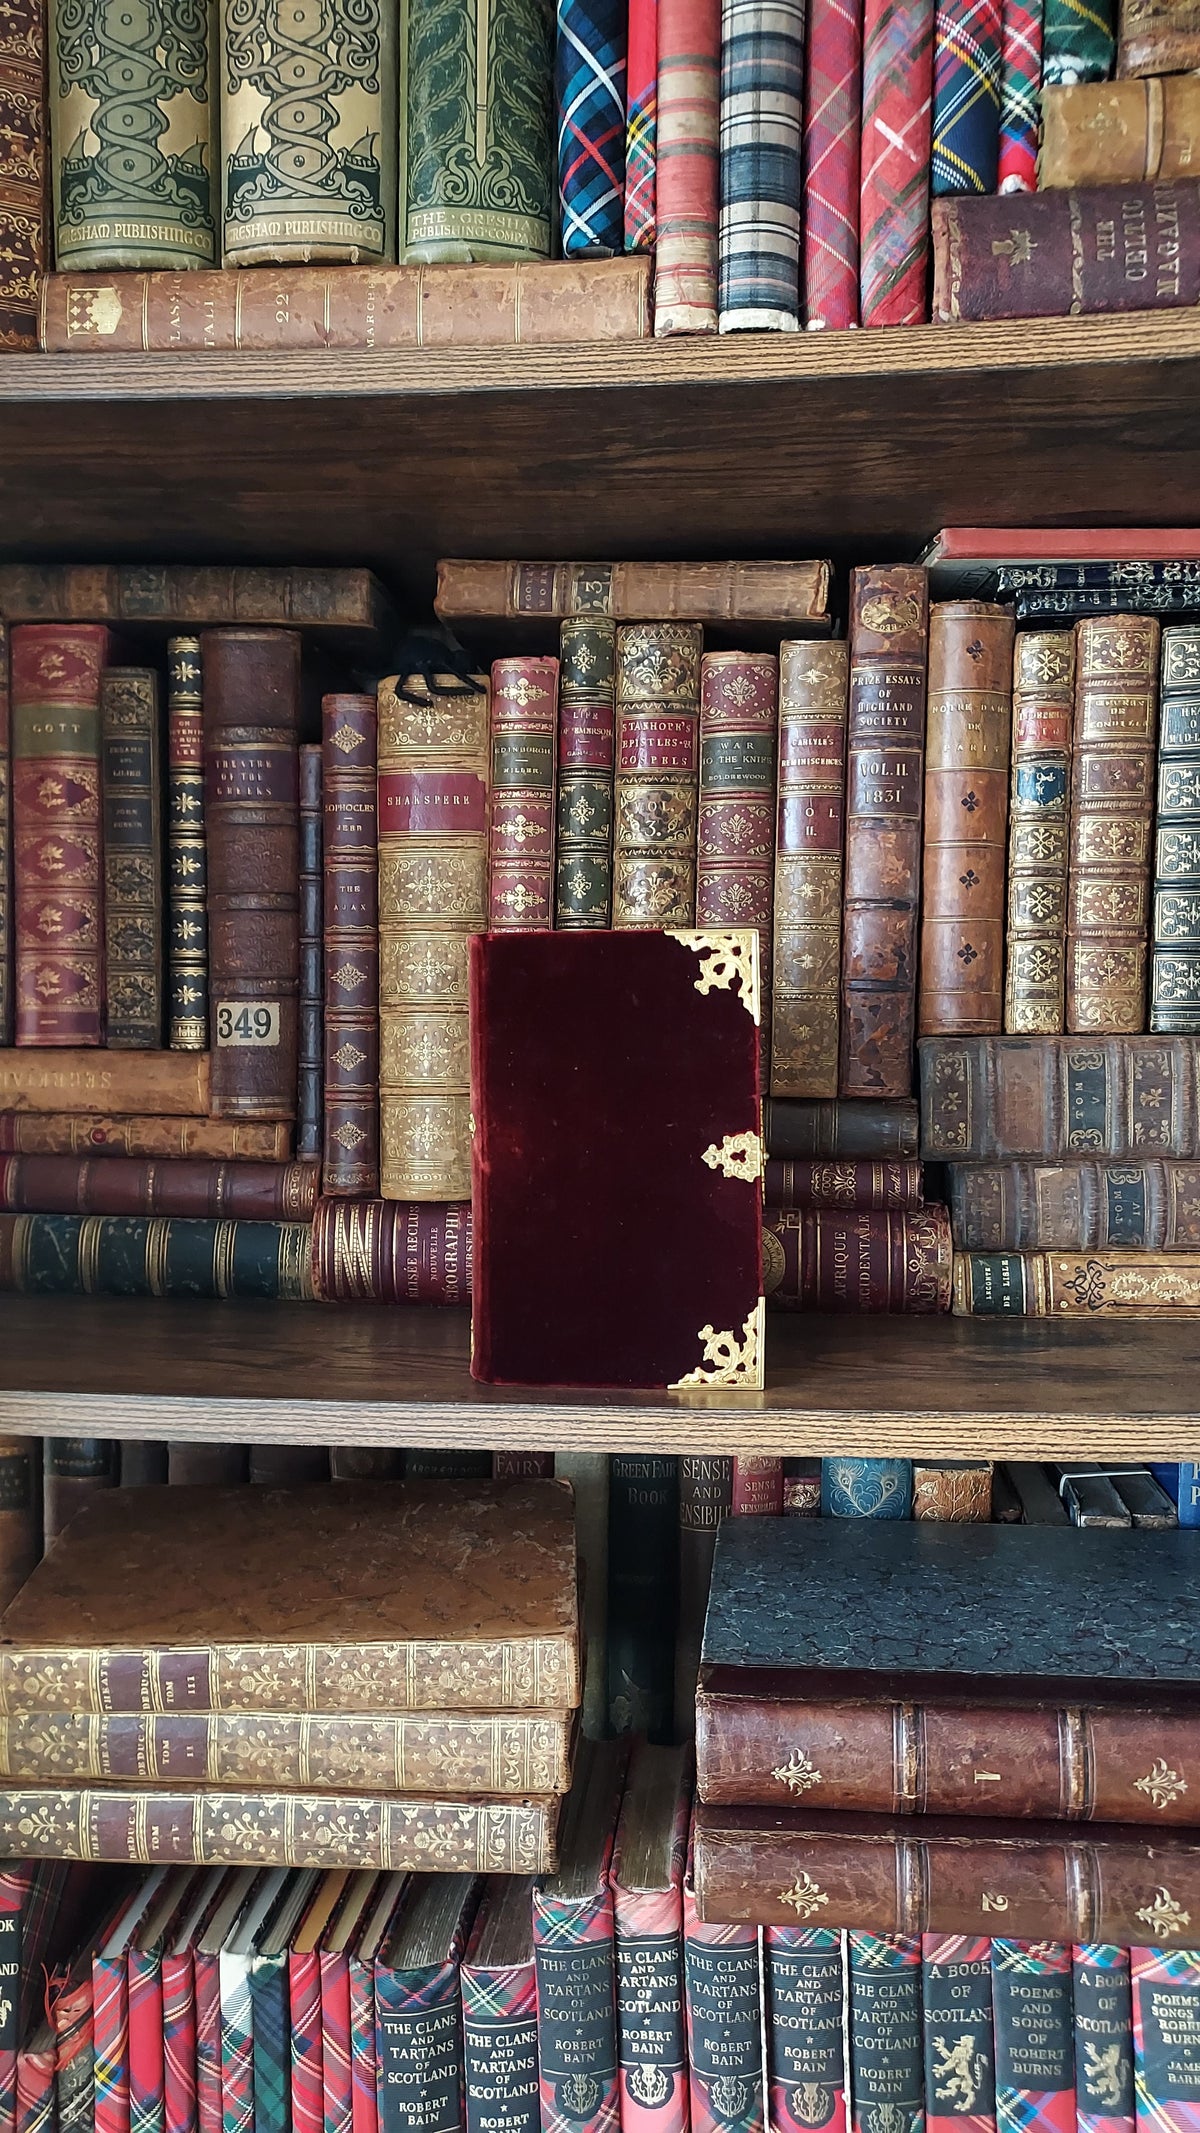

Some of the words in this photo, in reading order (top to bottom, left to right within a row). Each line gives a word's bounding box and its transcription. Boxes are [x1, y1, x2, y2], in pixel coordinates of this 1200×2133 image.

[412, 211, 447, 227] THE
[114, 223, 193, 245] PUBLISHING
[194, 233, 211, 250] CO
[285, 220, 362, 238] PUBLISHING
[364, 226, 381, 243] CO
[1096, 220, 1116, 262] THE
[1122, 199, 1148, 282] CELTIC
[275, 294, 290, 323] 22
[852, 675, 881, 686] PRIZE
[885, 674, 921, 685] ESSAYS
[878, 689, 892, 698] OF
[857, 703, 913, 713] HIGHLAND
[622, 721, 692, 733] STANHOPE'S
[860, 717, 908, 727] SOCIETY
[720, 741, 754, 751] WAR
[792, 735, 834, 747] CARLYLE'S
[215, 760, 272, 769] THEATRE
[622, 756, 688, 767] GOSPELS
[719, 755, 738, 763] THE
[708, 773, 766, 782] BOLDREWOOD
[387, 795, 470, 806] SHAKSPERE
[864, 789, 901, 804] 1831
[333, 903, 367, 911] AJAX
[218, 1007, 272, 1039] 349
[1075, 1082, 1084, 1119] TOM
[407, 1205, 420, 1252] RECLUS
[430, 1227, 438, 1281] NOUVELLE
[834, 1231, 849, 1298] AFRIQUE
[1002, 1259, 1011, 1288] LISLE
[496, 1456, 545, 1475] FAIRY
[682, 1457, 731, 1482] SENSE
[692, 1486, 722, 1499] AND
[745, 1480, 776, 1493] SENSE
[166, 1680, 175, 1704] TOM
[162, 1739, 171, 1765] TOM
[151, 1825, 160, 1851] TOM
[982, 1893, 1009, 1912] 2
[541, 1958, 568, 1972] THE
[571, 1953, 613, 1970] CLANS
[617, 1952, 632, 1964] HE
[635, 1948, 679, 1965] CLANS
[688, 1952, 713, 1971] THE
[716, 1957, 758, 1973] CLANS
[630, 1965, 656, 1974] AND
[771, 1961, 799, 1976] THE
[928, 1964, 943, 1979] A
[566, 1973, 590, 1982] AND
[617, 1975, 678, 1988] ARTANS
[712, 1974, 737, 1983] AND
[796, 1979, 821, 1989] AND
[1079, 1971, 1091, 1986] A
[545, 1981, 610, 1997] TARTANS
[637, 1989, 653, 2000] OF
[692, 1980, 758, 1998] TARTANS
[853, 1983, 874, 1998] HE
[878, 1983, 917, 1998] CLAN
[950, 1985, 972, 1998] OF
[1010, 1985, 1063, 1998] POEMS
[571, 1999, 585, 2008] OF
[774, 1988, 841, 2005] TARTANS
[1098, 1997, 1118, 2010] OF
[618, 1999, 681, 2014] COTLAND
[717, 2000, 733, 2009] OF
[801, 2006, 816, 2016] OF
[872, 2000, 898, 2009] AND
[1022, 2003, 1053, 2014] AND
[543, 2005, 613, 2022] SCOTLAND
[692, 2004, 760, 2024] SCOTLAND
[853, 2008, 918, 2025] TARTANS
[1152, 2005, 1194, 2020] SONGS
[384, 2022, 412, 2035] THE
[416, 2014, 457, 2034] CLANS
[772, 2013, 842, 2031] SCOTLAND
[1012, 2016, 1062, 2029] SONGS
[622, 2028, 673, 2042] ROBERT
[877, 2026, 893, 2036] OF
[411, 2035, 434, 2045] AND
[466, 2032, 492, 2048] THE
[495, 2030, 537, 2047] CLANS
[555, 2038, 604, 2051] ROBERT
[703, 2037, 752, 2053] ROBERT
[1027, 2033, 1048, 2044] OF
[390, 2039, 454, 2060] TARTANS
[490, 2049, 514, 2059] AND
[631, 2042, 664, 2055] BAIN
[784, 2046, 836, 2060] ROBERT
[1009, 2047, 1066, 2060] ROBERT
[563, 2052, 596, 2063] BAIN
[711, 2054, 744, 2067] BAIN
[415, 2061, 430, 2070] OF
[470, 2057, 535, 2074] TARTANS
[793, 2060, 827, 2073] BAIN
[1012, 2062, 1062, 2076] BURNS
[387, 2064, 458, 2084] SCOTLAND
[495, 2075, 510, 2084] OF
[860, 2066, 912, 2081] ROBERT
[469, 2082, 539, 2100] SCOTLAND
[869, 2081, 902, 2093] BAIN
[399, 2096, 448, 2112] ROBERT
[407, 2111, 440, 2126] BAIN
[480, 2113, 529, 2128] ROBERT
